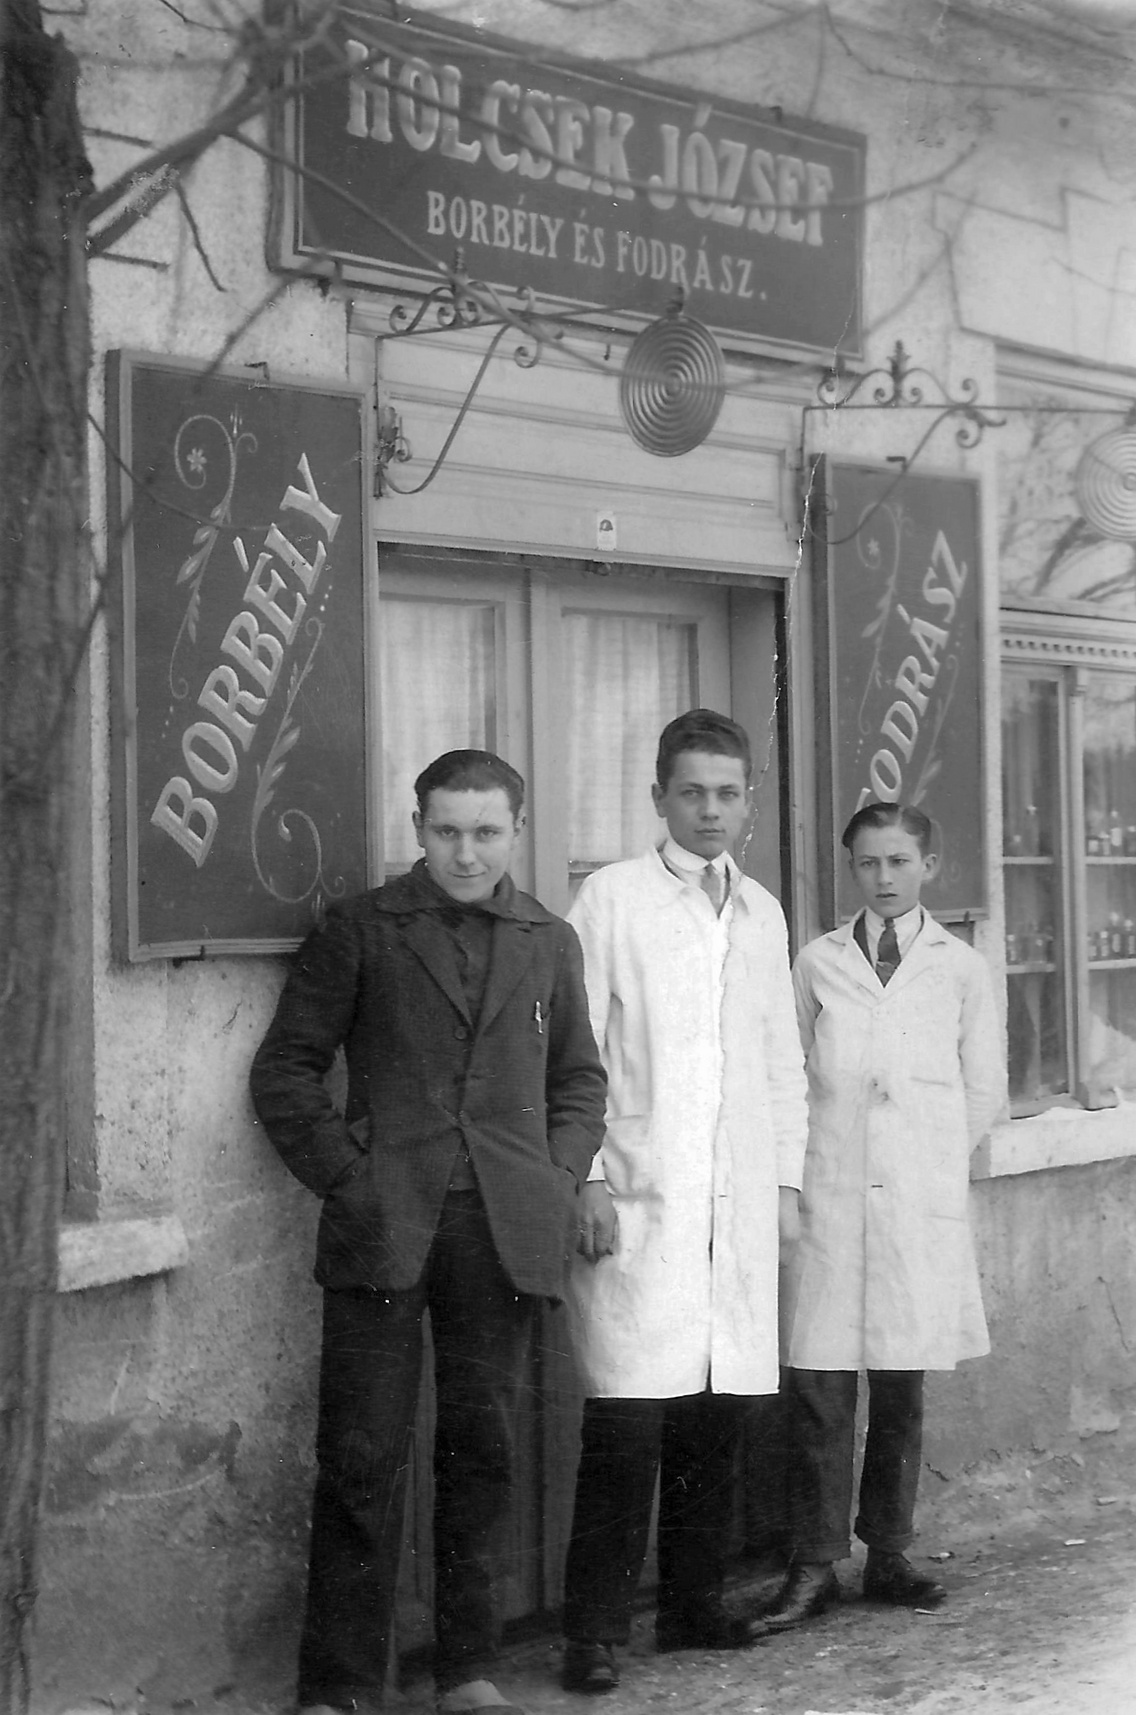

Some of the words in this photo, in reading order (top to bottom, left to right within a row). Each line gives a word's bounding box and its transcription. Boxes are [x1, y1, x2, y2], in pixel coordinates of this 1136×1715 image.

[427, 190, 564, 259] BORBÉLY
[573, 208, 606, 269] ÉS
[617, 231, 767, 300] FODRÁSZ.
[648, 104, 834, 247] JÓZSEF
[150, 452, 341, 867] BORBÉLY
